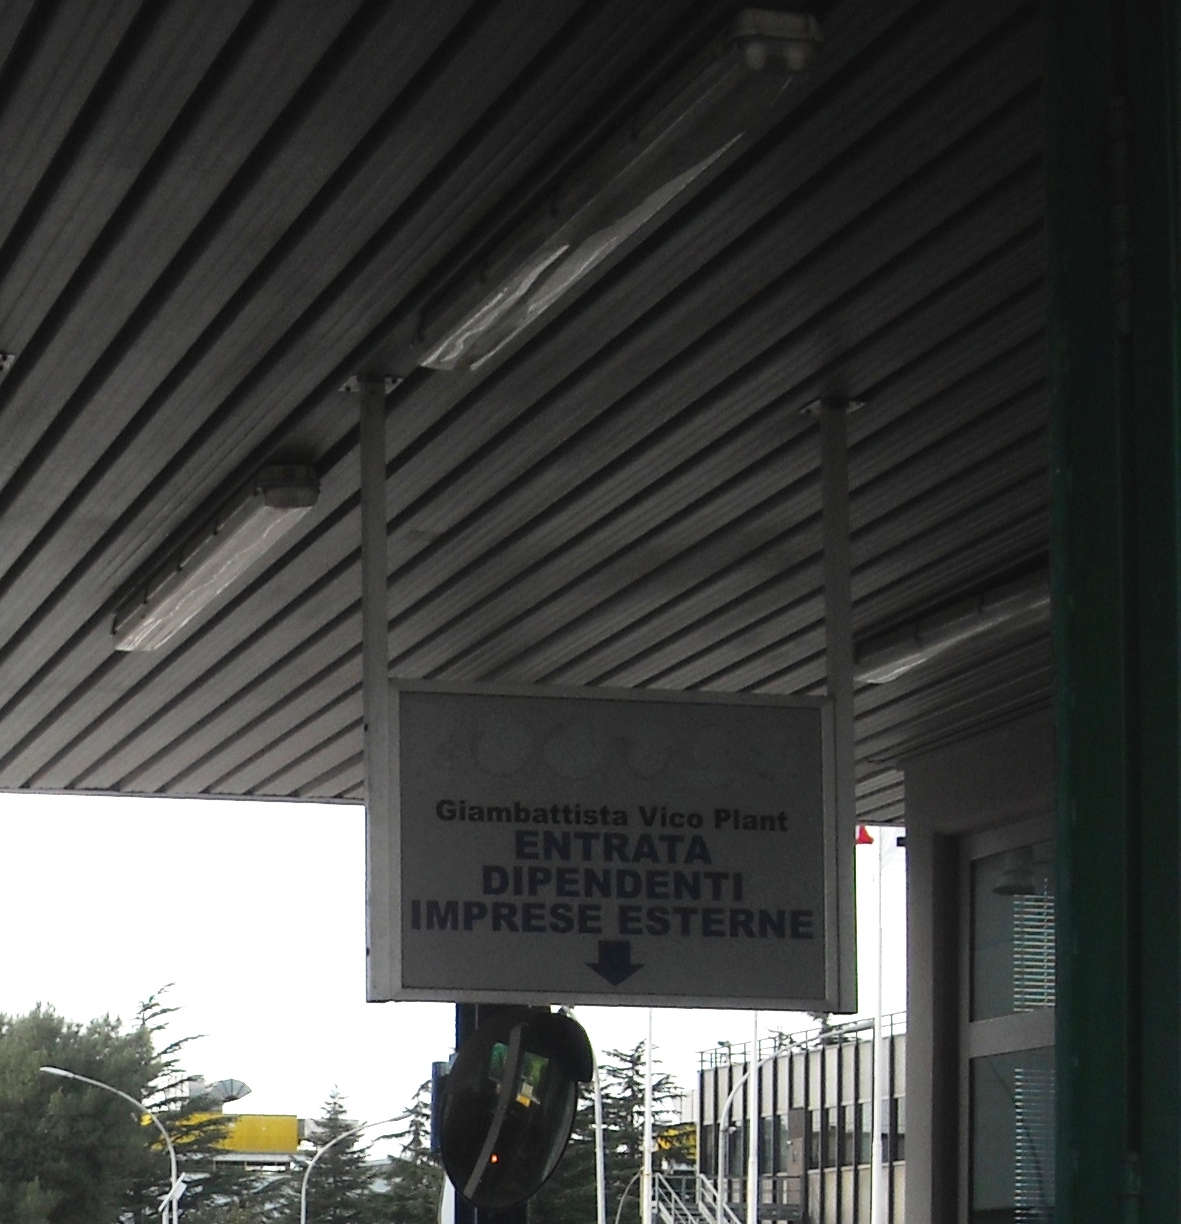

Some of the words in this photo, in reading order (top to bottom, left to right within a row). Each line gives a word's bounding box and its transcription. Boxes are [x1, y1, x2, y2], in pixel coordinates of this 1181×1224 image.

[435, 800, 628, 827] Giambattista
[638, 806, 704, 829] Vico
[714, 808, 788, 833] Plant
[515, 830, 712, 865] ENTRATA
[482, 865, 743, 901] DIPENDENTI
[412, 900, 603, 934] IMPRESE
[619, 906, 814, 940] ESTERNE
